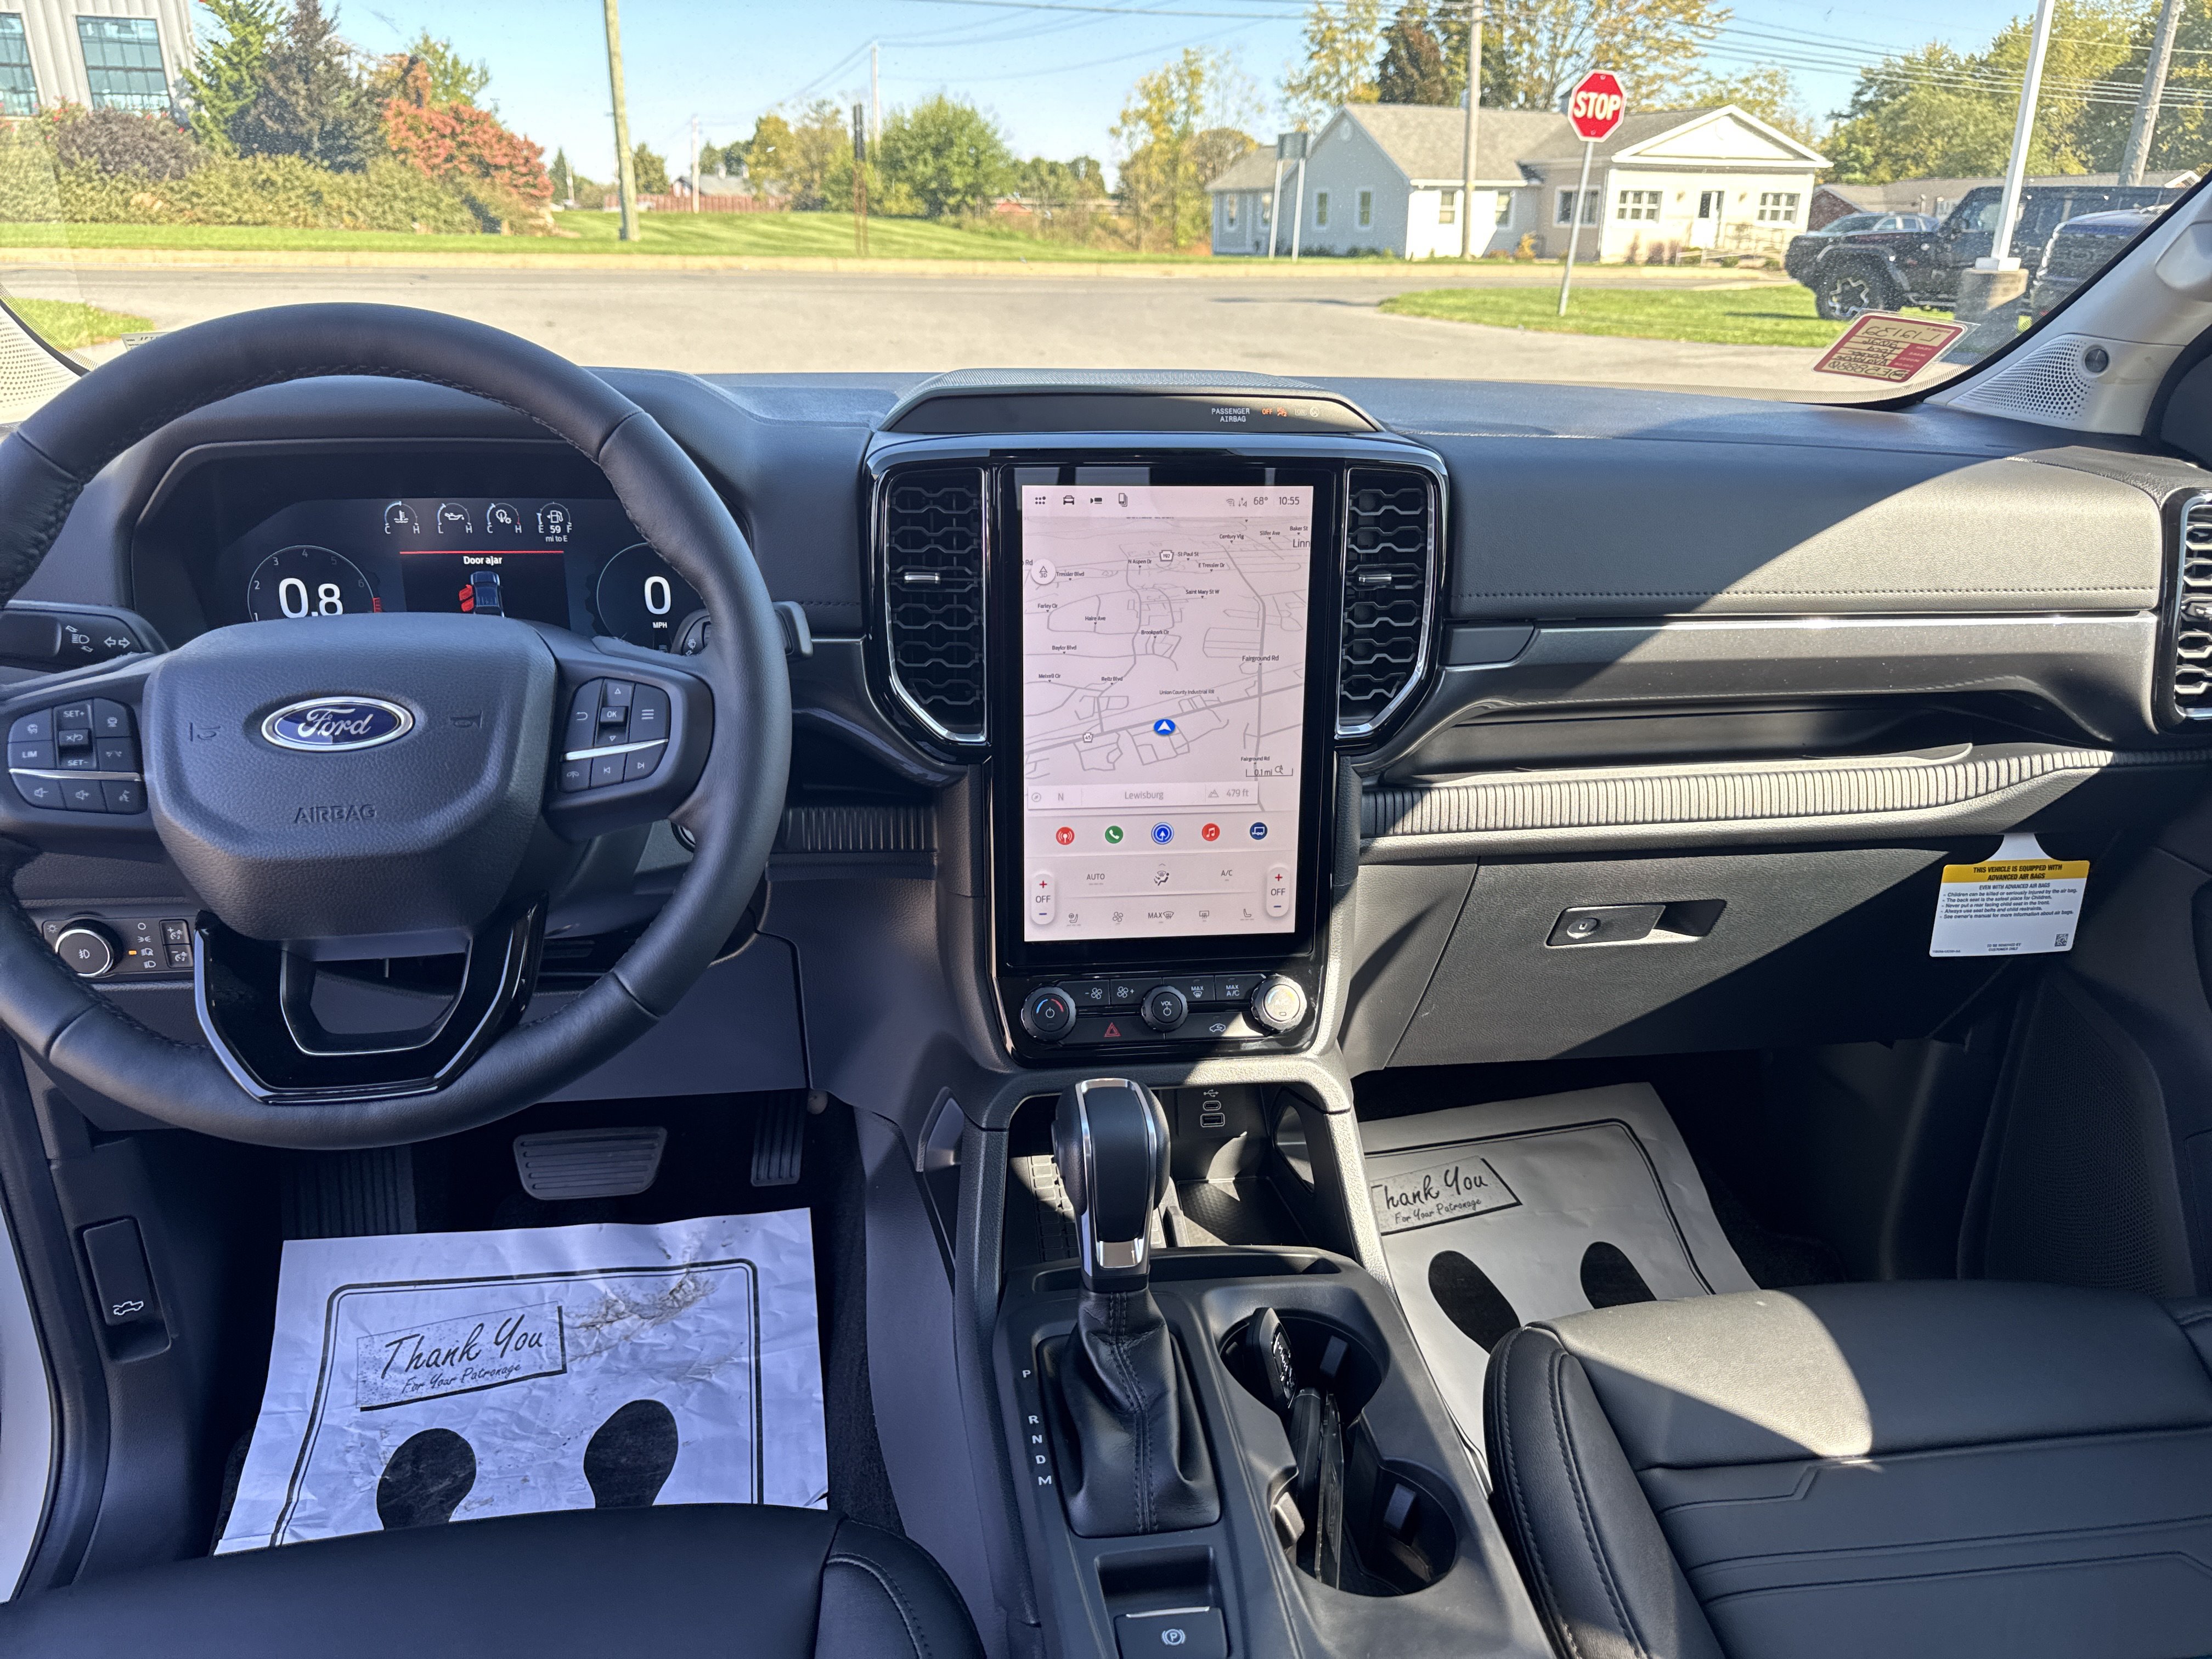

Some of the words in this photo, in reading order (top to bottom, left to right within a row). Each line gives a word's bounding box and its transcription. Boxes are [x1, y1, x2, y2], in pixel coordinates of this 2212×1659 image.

[1573, 91, 1621, 121] STOP
[1254, 496, 1268, 505] 68°
[1279, 496, 1300, 505] 10:55
[385, 526, 391, 534] C
[413, 526, 420, 534] H
[438, 526, 444, 534] L
[466, 526, 472, 534] H
[487, 526, 493, 534] C
[516, 526, 522, 534] H
[539, 525, 544, 533] E
[550, 526, 561, 534] 59
[1293, 539, 1310, 548] Linn
[302, 549, 308, 557] 4
[273, 557, 279, 566] 3
[331, 556, 337, 565] 5
[464, 556, 484, 565] Door
[486, 557, 503, 566] ajar
[254, 580, 260, 590] 2
[358, 579, 364, 588] 6
[279, 578, 343, 618] 0.8
[644, 576, 671, 614] 0
[253, 613, 258, 622] 1
[297, 708, 374, 737] Ford
[22, 751, 38, 759] LIM
[1058, 793, 1064, 802] N
[1124, 790, 1164, 801] Lewisburg
[294, 804, 377, 823] AIRBAG
[1444, 1166, 1488, 1195] You
[1395, 1212, 1410, 1224] For
[1436, 1199, 1481, 1215] Patronage
[381, 1322, 484, 1379] Thank
[493, 1314, 544, 1359] You
[402, 1376, 424, 1393] For
[430, 1373, 454, 1390] Your
[461, 1363, 521, 1383] Patronage
[1022, 1369, 1031, 1378] P
[1028, 1415, 1039, 1424] R
[1032, 1435, 1042, 1444] N
[1035, 1455, 1046, 1464] D
[1038, 1475, 1052, 1485] M
